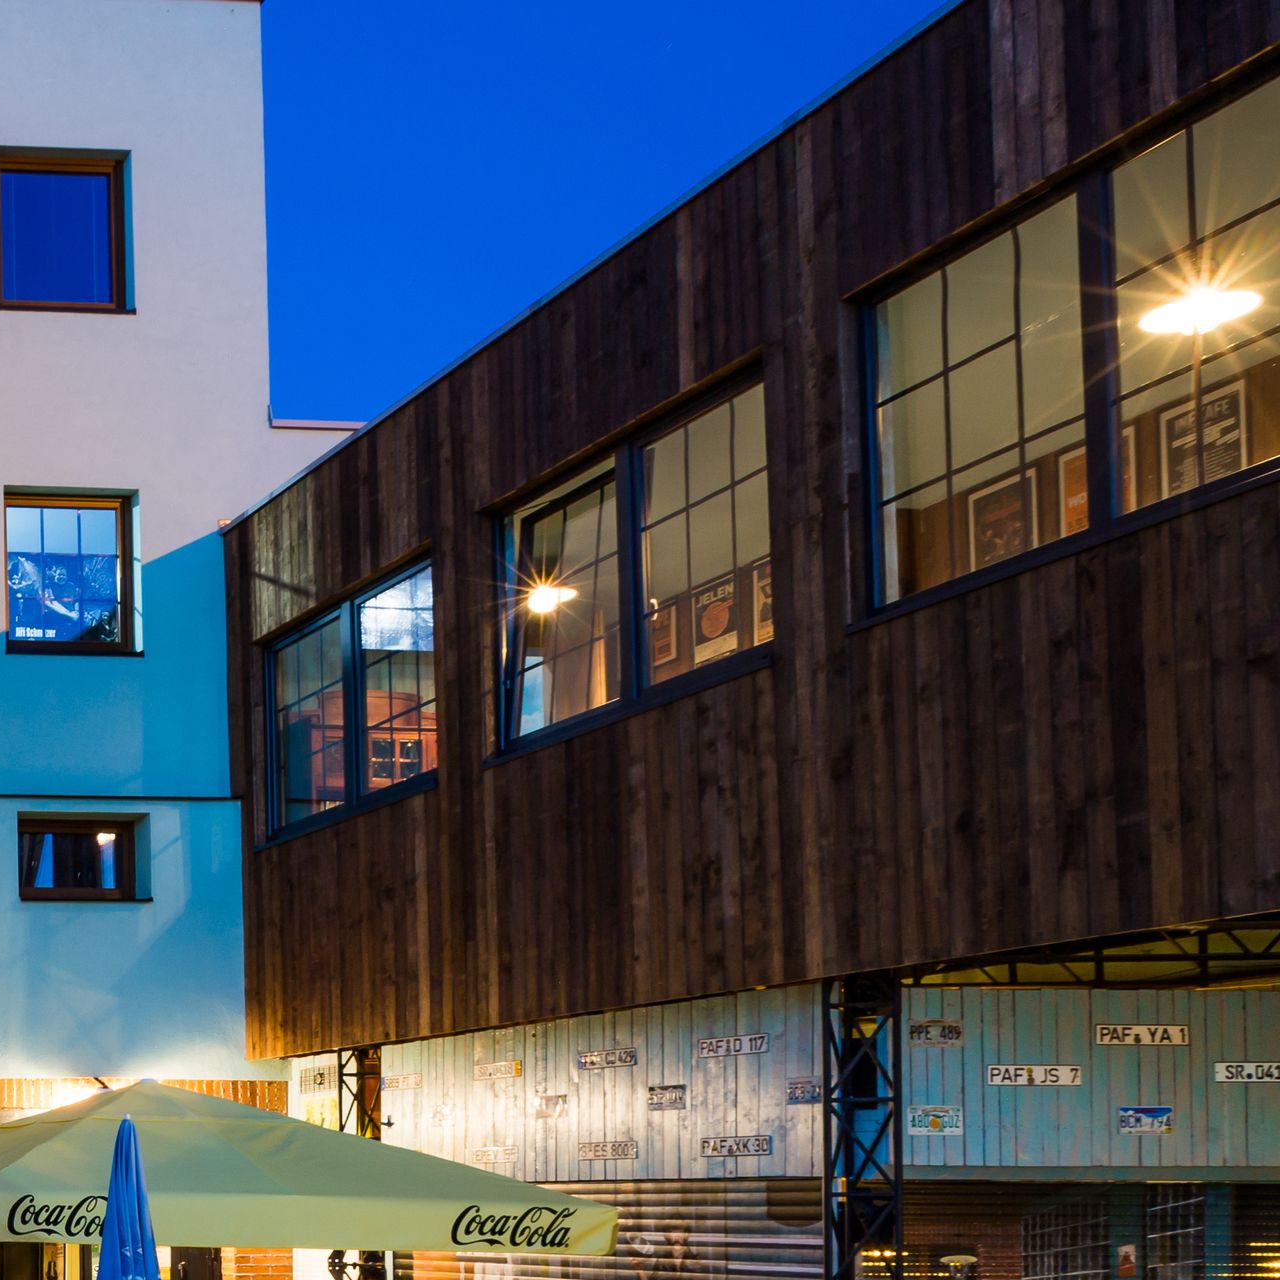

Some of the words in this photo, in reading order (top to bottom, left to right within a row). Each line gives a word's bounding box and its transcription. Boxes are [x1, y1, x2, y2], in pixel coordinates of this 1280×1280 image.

[696, 582, 734, 608] JELEN
[910, 1025, 932, 1040] PPE
[940, 1025, 961, 1040] 489
[1100, 1027, 1134, 1042] PAF
[1147, 1028, 1173, 1043] YA
[1180, 1028, 1187, 1043] 1
[701, 1040, 724, 1055] PAF
[733, 1038, 742, 1053] D
[749, 1036, 766, 1051] 117
[990, 1068, 1025, 1083] PAF
[1040, 1068, 1060, 1083] JS
[1071, 1068, 1078, 1083] 7
[702, 1140, 727, 1154] PAF
[734, 1139, 750, 1153] XK
[753, 1138, 768, 1152] 30
[7, 1194, 108, 1237] Coca-Co
[451, 1205, 578, 1248] Coca-Cola
